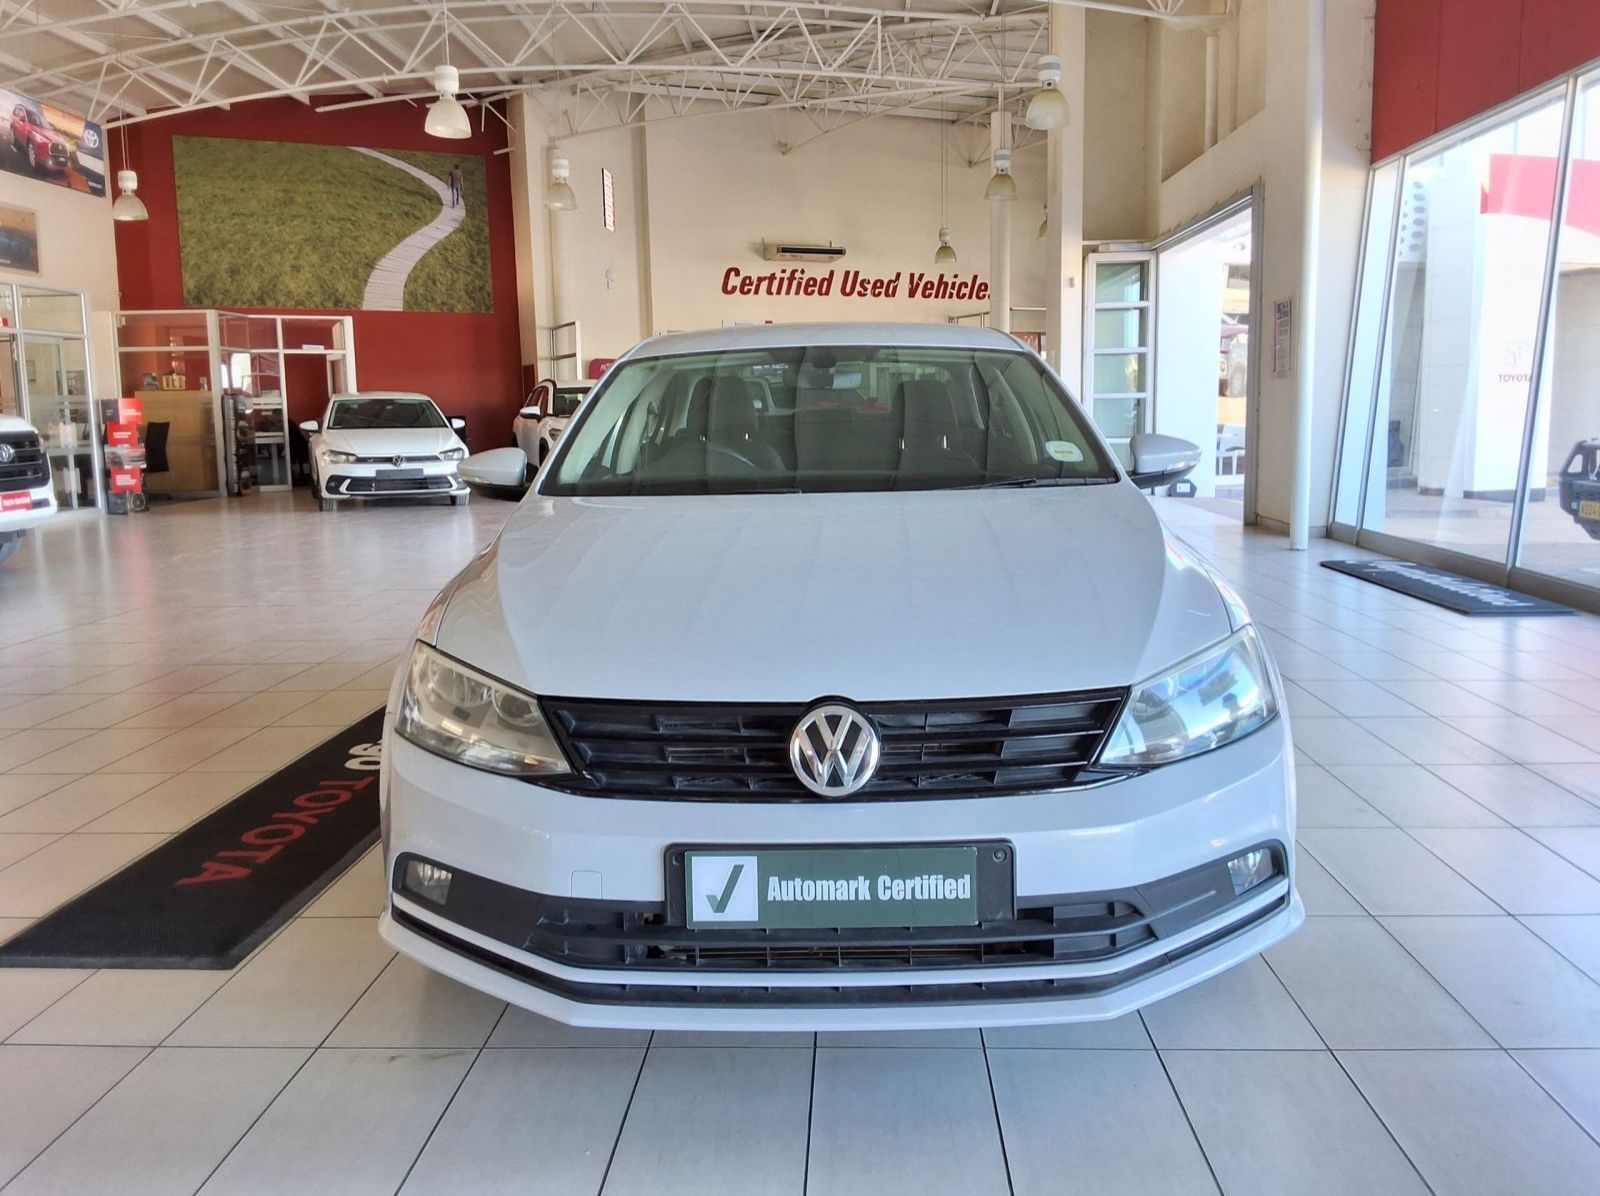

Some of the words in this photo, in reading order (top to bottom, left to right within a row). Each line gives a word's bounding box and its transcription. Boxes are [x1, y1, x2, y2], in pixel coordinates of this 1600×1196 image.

[721, 267, 835, 297] Certified
[840, 270, 901, 298] Used
[907, 272, 991, 300] Vehicle
[1498, 374, 1532, 383] TOYOT
[174, 776, 375, 886] TOYOTA
[767, 876, 870, 901] Automark
[877, 874, 971, 900] Certified
